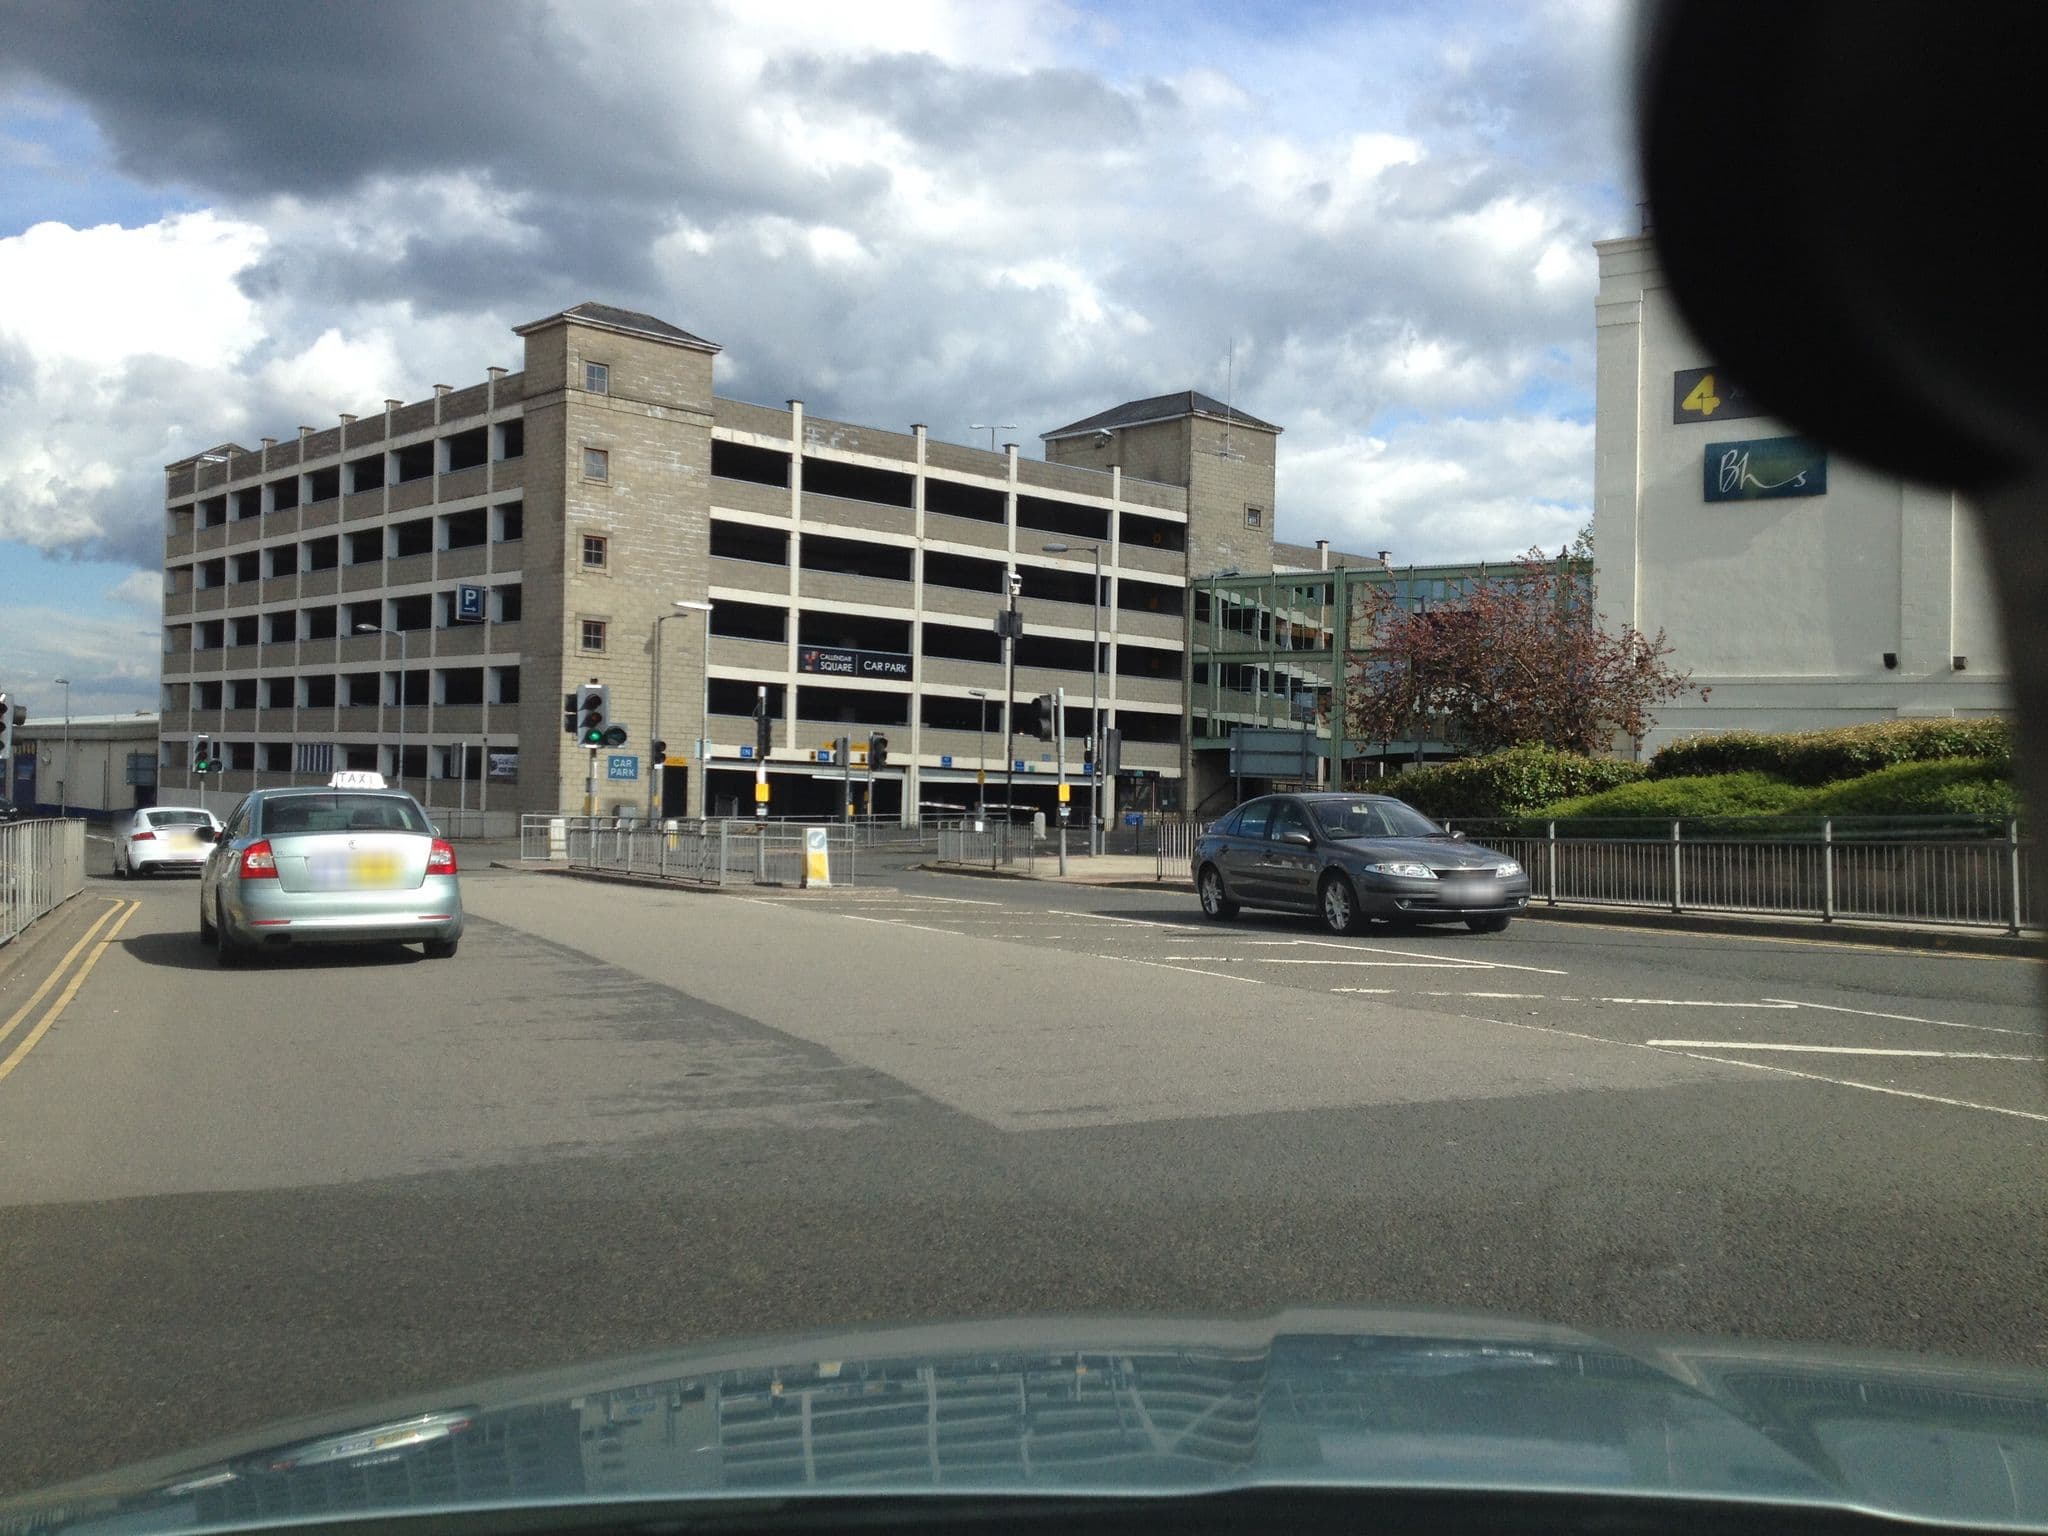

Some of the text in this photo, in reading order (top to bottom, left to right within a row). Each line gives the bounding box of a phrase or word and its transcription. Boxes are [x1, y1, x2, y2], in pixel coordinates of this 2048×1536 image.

[465, 589, 477, 605] P
[820, 661, 854, 673] SQUARE
[863, 660, 907, 673] CAR PARK
[613, 759, 633, 767] CAR
[338, 772, 373, 784] TAXI
[610, 768, 635, 777] PARK
